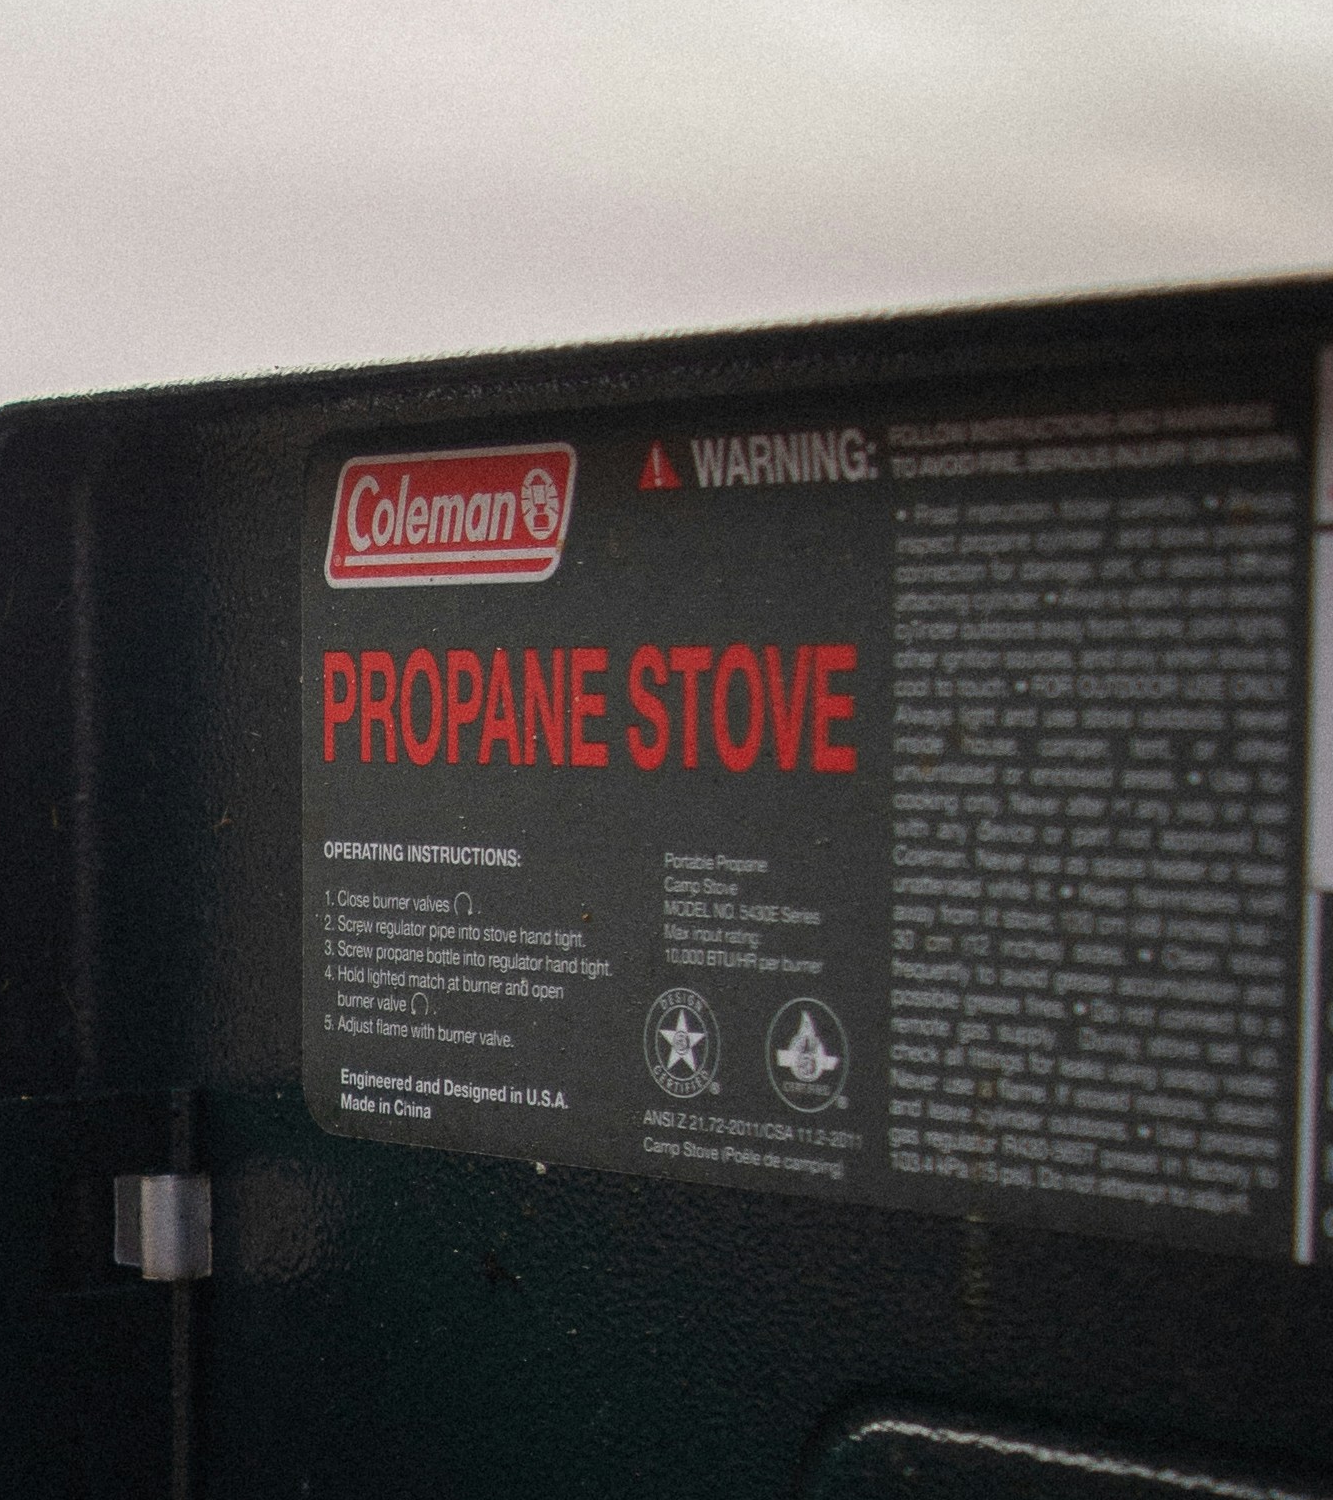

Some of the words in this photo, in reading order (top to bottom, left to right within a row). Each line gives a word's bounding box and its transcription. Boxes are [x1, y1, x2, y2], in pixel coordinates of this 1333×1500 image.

[691, 427, 879, 488] WARNING:
[348, 475, 516, 552] Coleman
[323, 647, 609, 767] PROPANE
[627, 643, 857, 772] STOVE
[324, 841, 403, 861] OPERATING
[407, 845, 521, 867] INSTRUCTIONS:
[716, 854, 768, 874] Propane
[664, 876, 700, 897] Camp
[703, 878, 738, 896] Stove
[325, 890, 334, 906] 1.
[337, 890, 370, 908] Close
[373, 896, 409, 910] burner
[413, 897, 449, 913] valves
[663, 901, 711, 918] MODEL
[325, 915, 334, 931] 2.
[337, 916, 373, 933] Screw
[376, 921, 425, 939] regulator
[429, 925, 455, 940] pipe
[459, 924, 480, 940] into
[484, 928, 516, 942] stove
[519, 928, 551, 945] hand
[555, 930, 585, 950] tight.
[325, 940, 334, 956] 3.
[337, 941, 373, 959] Screw
[376, 948, 423, 963] propane
[427, 948, 459, 966] bottle
[463, 950, 485, 967] into
[489, 953, 543, 973] regulator
[545, 957, 577, 973] hand
[581, 959, 612, 979] tight.
[759, 958, 779, 972] per
[783, 957, 824, 974] burner
[325, 966, 334, 981] 4.
[338, 966, 364, 984] Hold
[367, 970, 405, 989] lighted
[409, 973, 444, 990] match
[448, 976, 459, 991] at
[463, 978, 502, 995] burner
[505, 979, 528, 997] and
[532, 984, 563, 1001] open
[337, 991, 374, 1008] burner
[377, 995, 406, 1012] valve
[661, 993, 703, 1012] DESIGN
[325, 1015, 333, 1030] 5.
[337, 1016, 373, 1036] Adjust
[376, 1019, 407, 1038] flame
[411, 1024, 435, 1040] with
[438, 1025, 477, 1044] burner
[480, 1030, 514, 1048] valve.
[341, 1068, 412, 1091] Engineered
[416, 1076, 441, 1095] and
[444, 1079, 506, 1103] Designed
[511, 1086, 522, 1103] in
[527, 1088, 569, 1109] U.S.A.
[341, 1094, 375, 1112] Made
[379, 1095, 391, 1114] in
[394, 1100, 431, 1119] China
[643, 1110, 674, 1127] ANSI
[678, 1113, 686, 1129] Z
[643, 1136, 680, 1157] Camp
[684, 1141, 719, 1160] Stove
[763, 1154, 780, 1167] de
